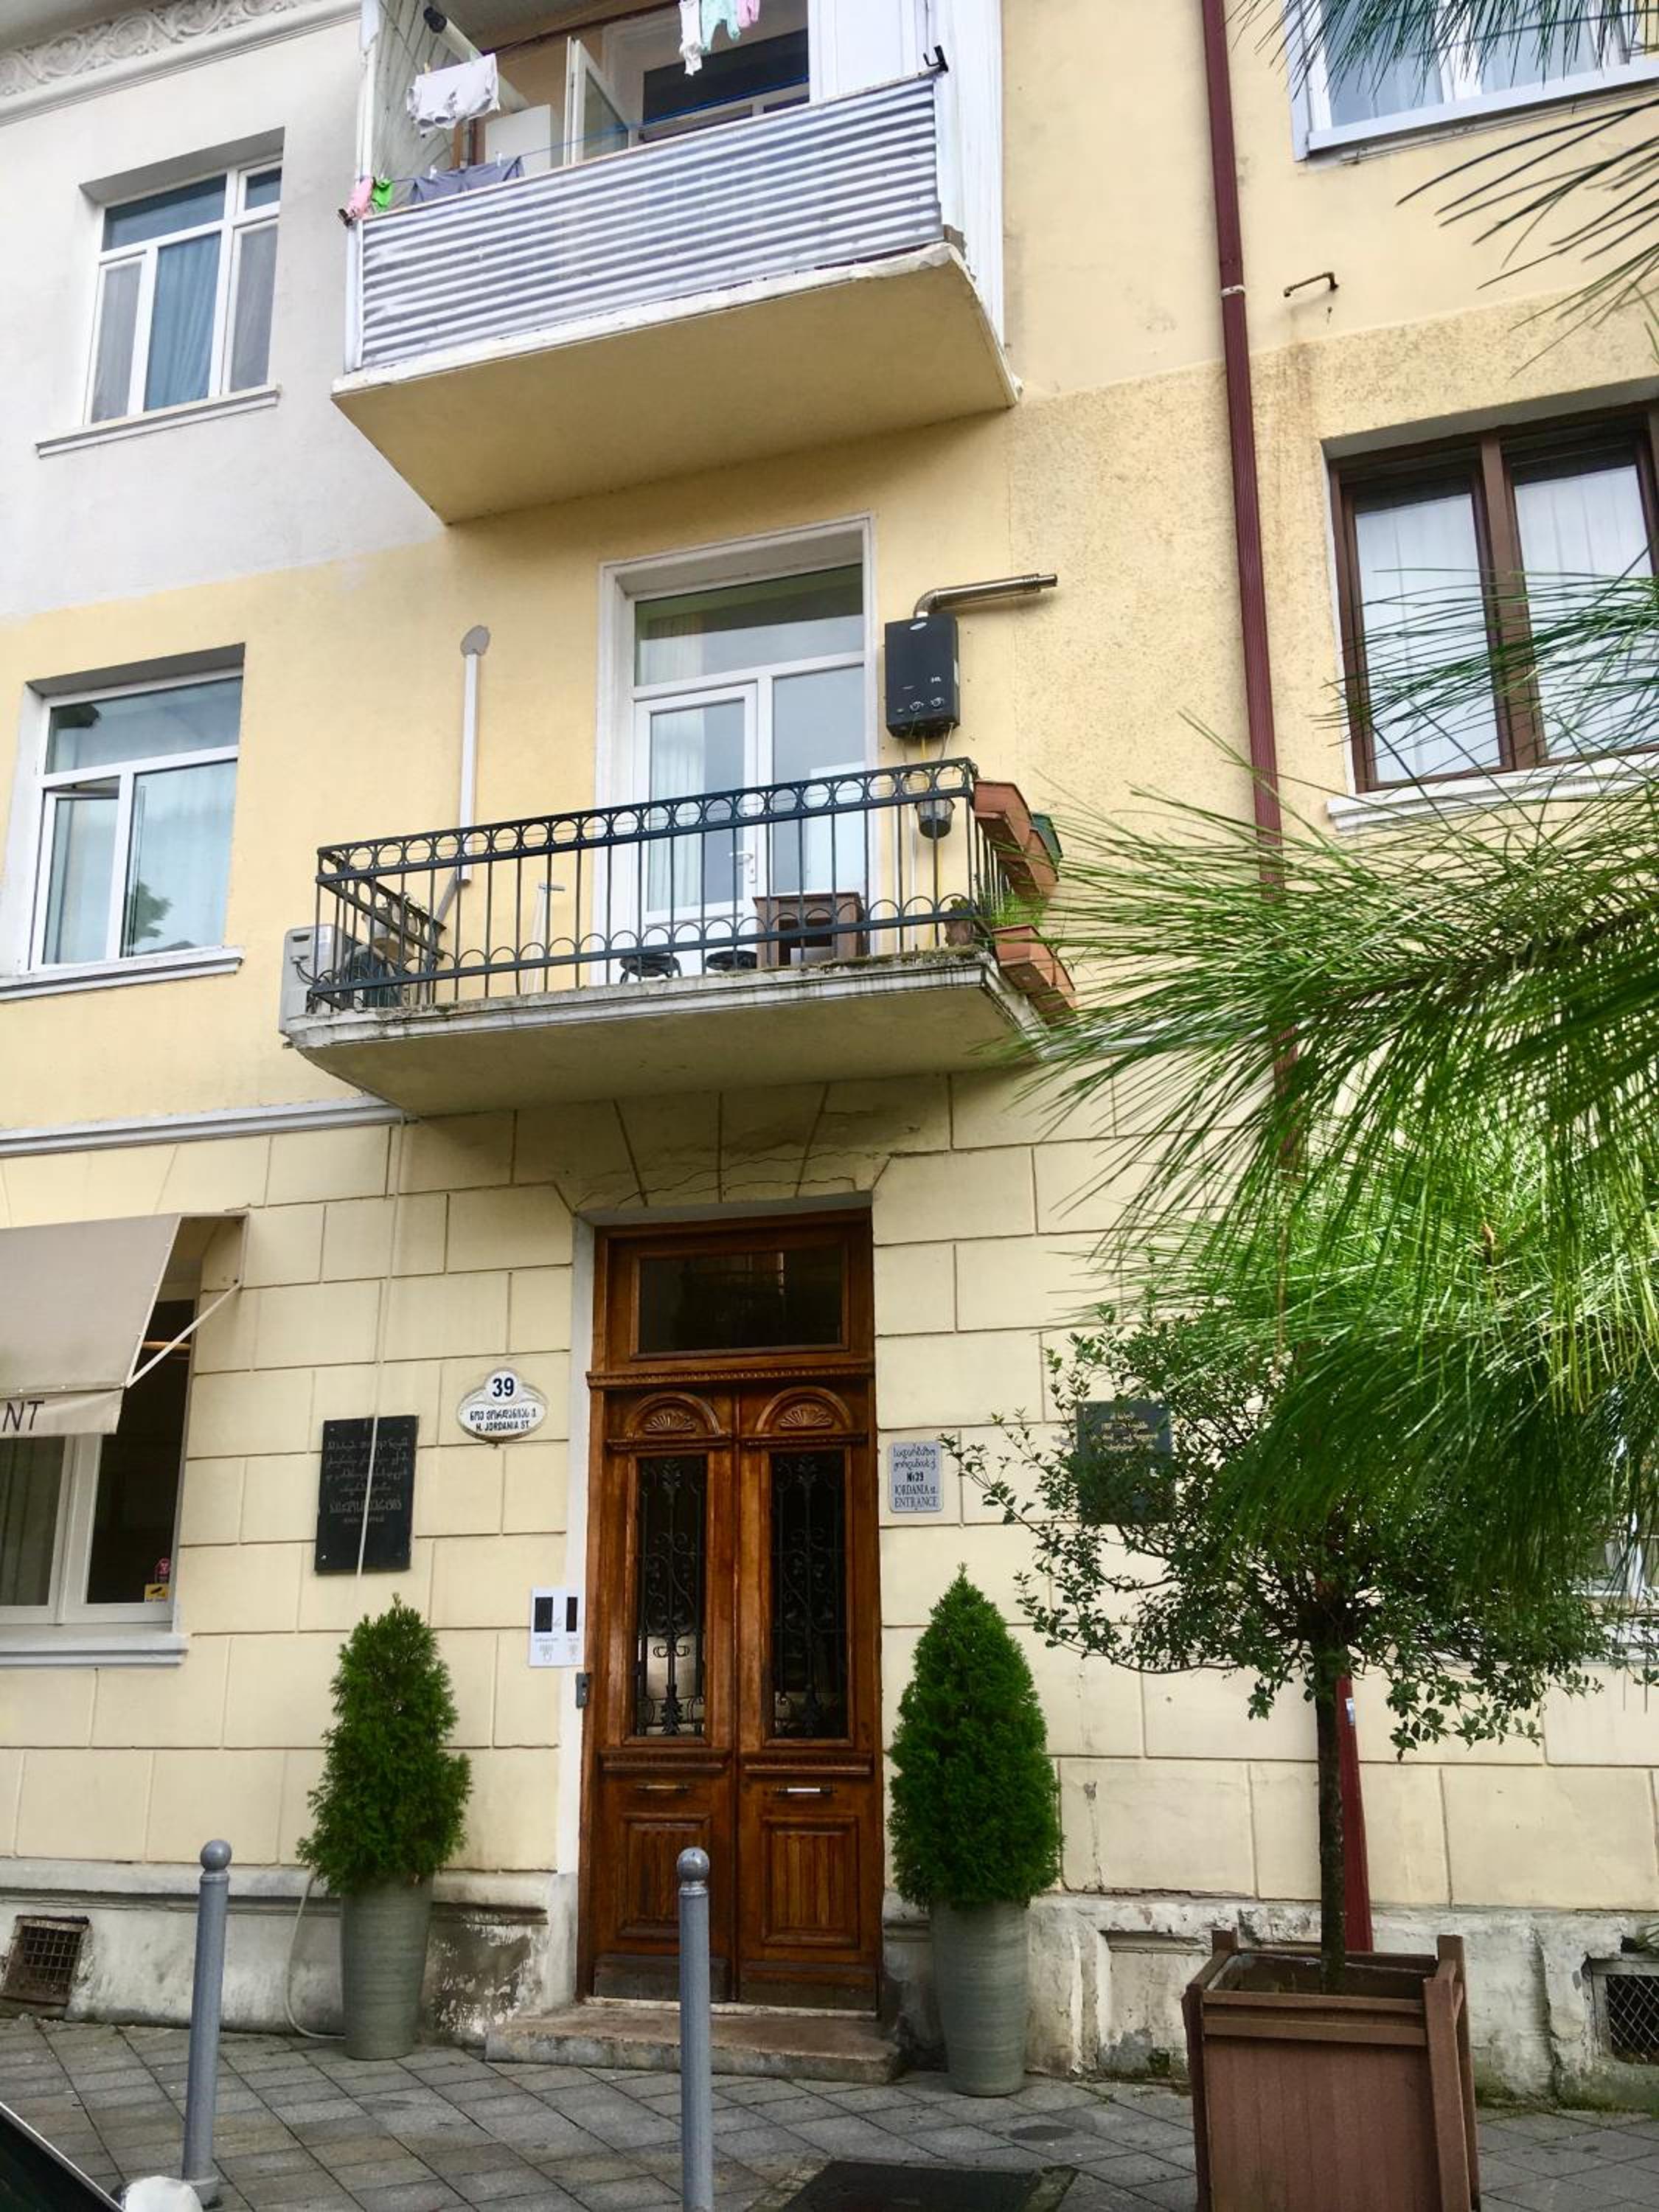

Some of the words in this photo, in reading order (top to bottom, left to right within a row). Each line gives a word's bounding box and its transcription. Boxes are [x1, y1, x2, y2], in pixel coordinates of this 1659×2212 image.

[493, 1377, 515, 1397] 39
[484, 1421, 519, 1431] JORDANIA
[894, 1497, 938, 1508] ENTRANCE
